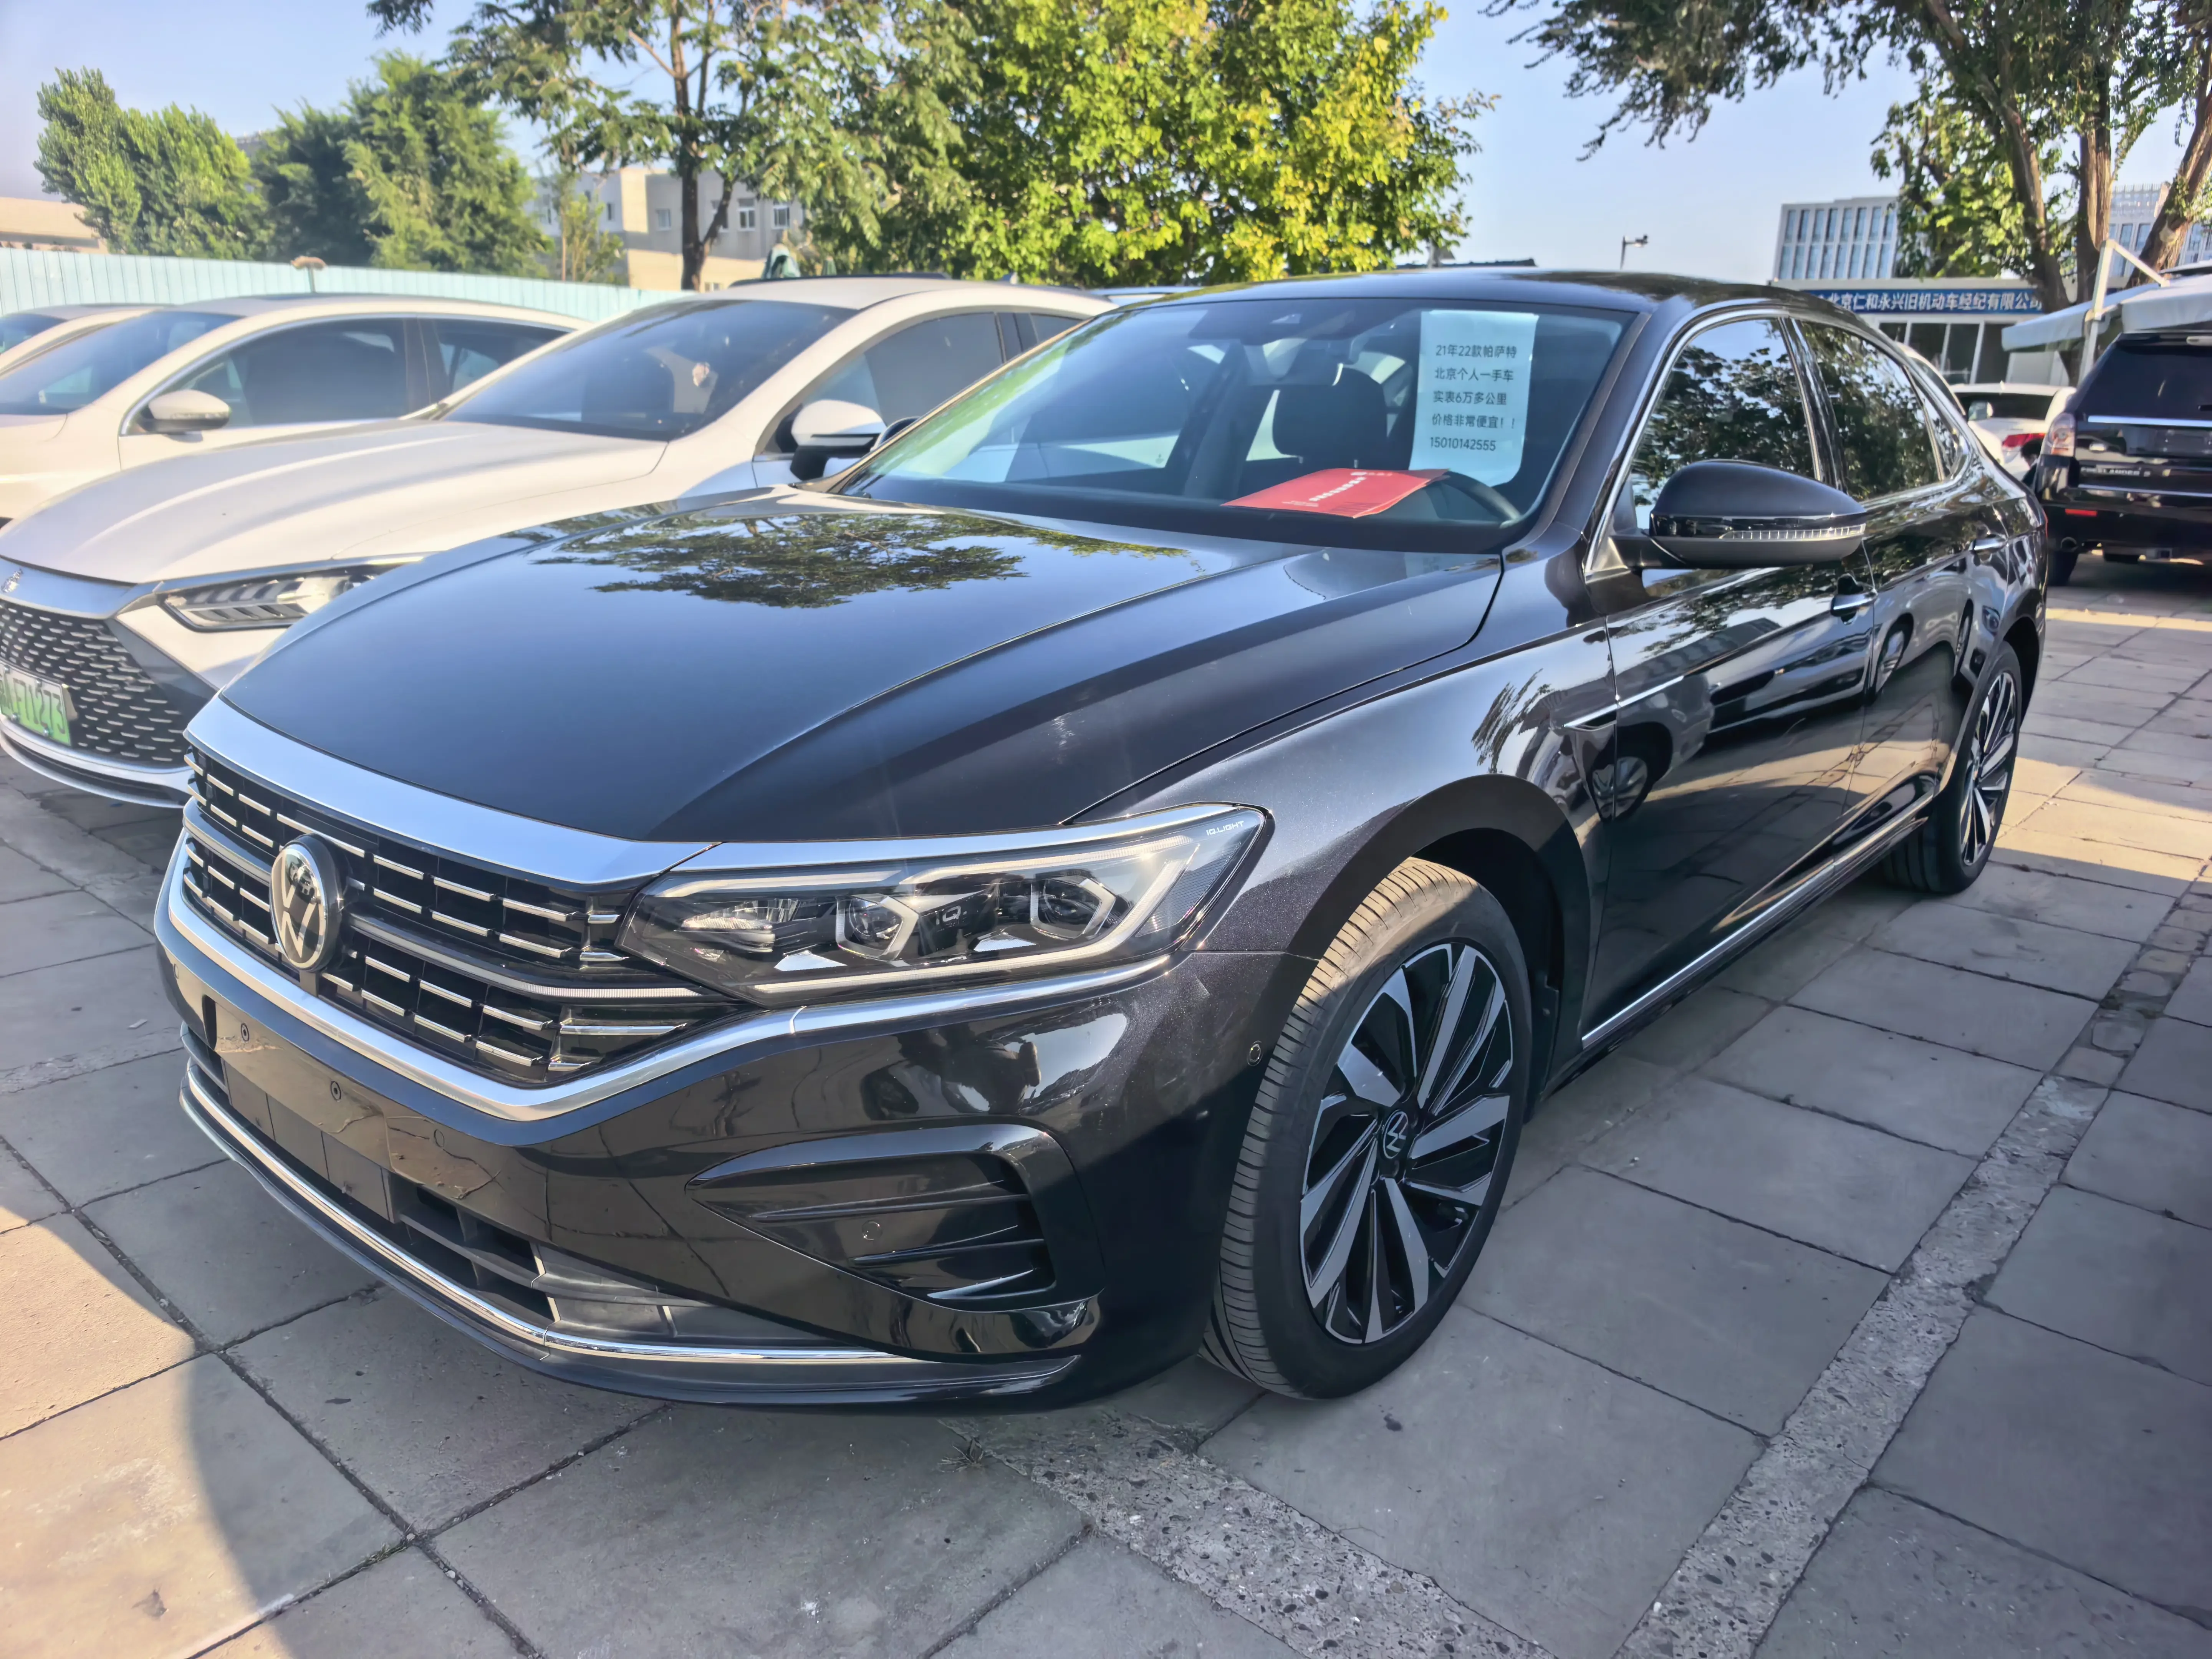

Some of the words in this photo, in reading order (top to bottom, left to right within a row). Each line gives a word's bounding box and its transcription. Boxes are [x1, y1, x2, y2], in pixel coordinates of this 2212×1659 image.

[1435, 344, 1517, 358] 21年22款帕萨特
[1434, 367, 1514, 382] 北京个人一手车
[1433, 390, 1507, 405] 实表6万多公里
[1430, 437, 1497, 451] 15010142555
[1206, 820, 1244, 836] IQ.LIGHT
